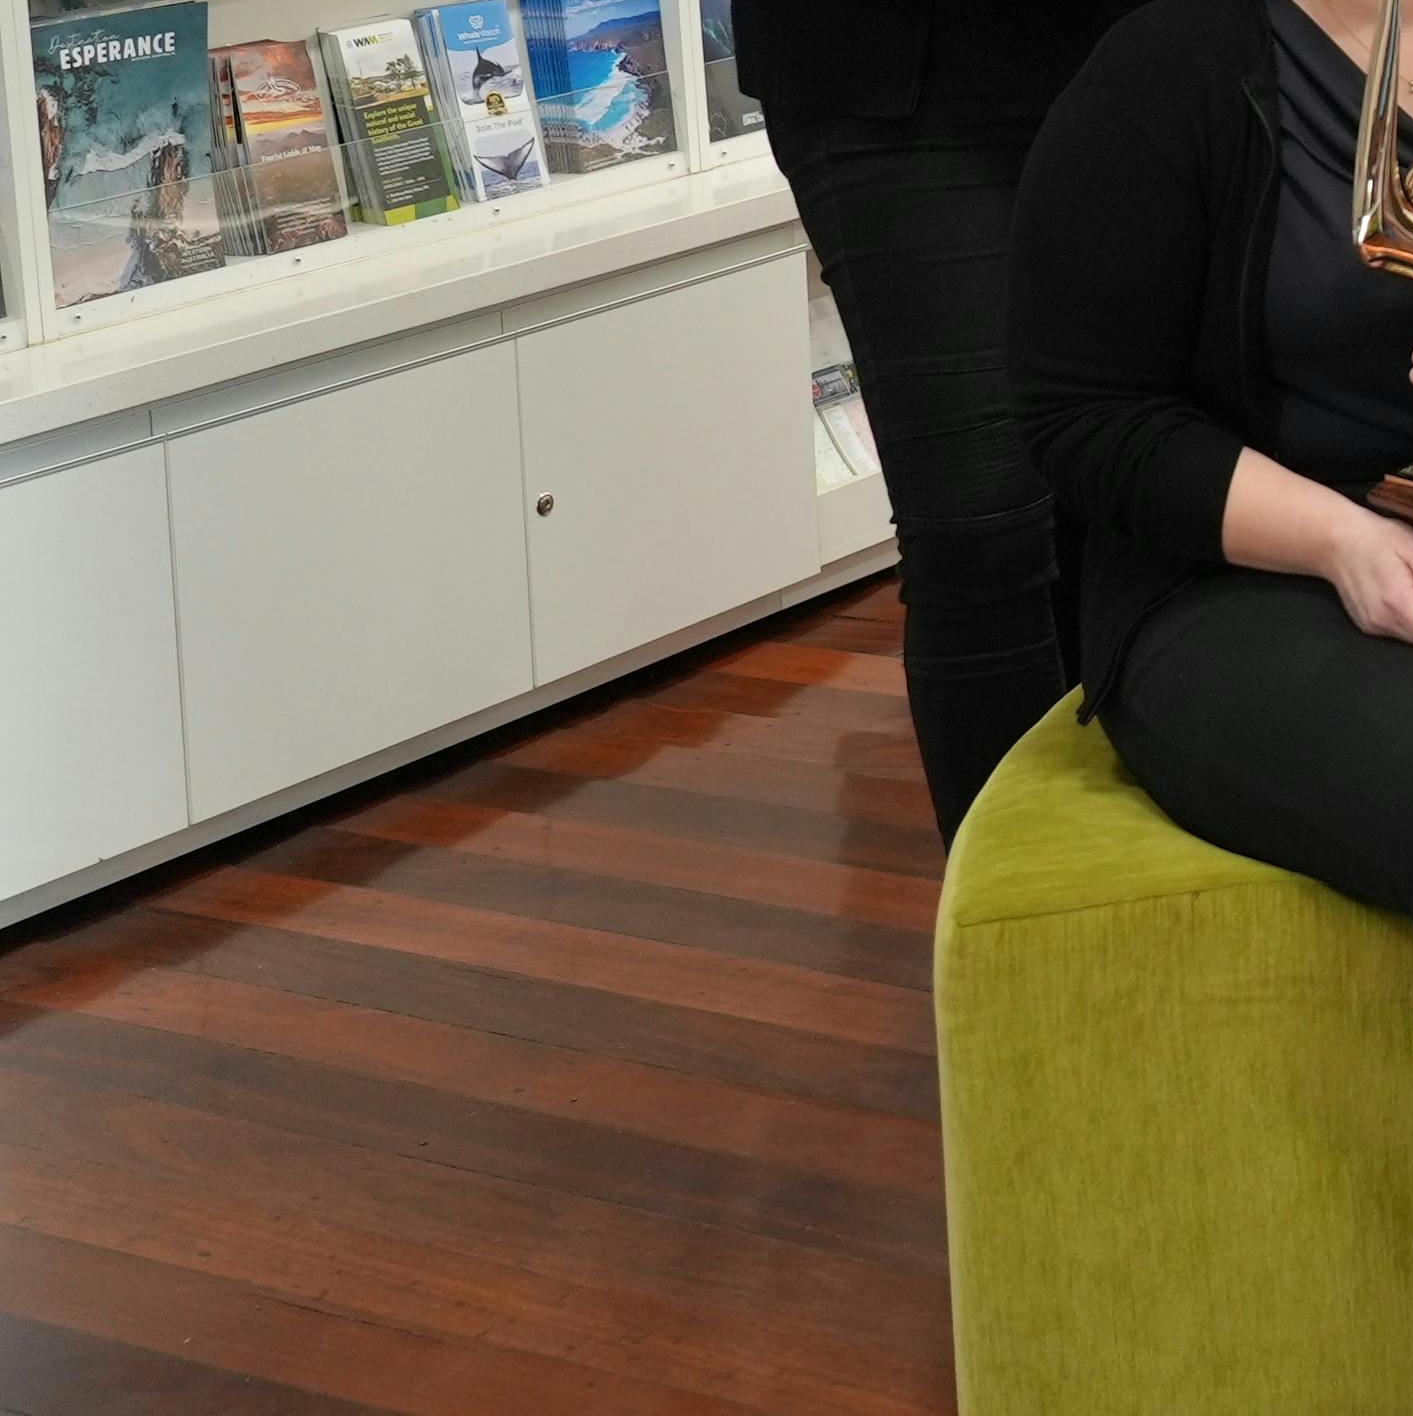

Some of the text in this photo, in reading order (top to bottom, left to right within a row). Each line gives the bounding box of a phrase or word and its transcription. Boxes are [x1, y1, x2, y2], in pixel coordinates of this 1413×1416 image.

[60, 31, 176, 70] ESPERANCE
[493, 121, 506, 130] The
[508, 119, 523, 129] Pod
